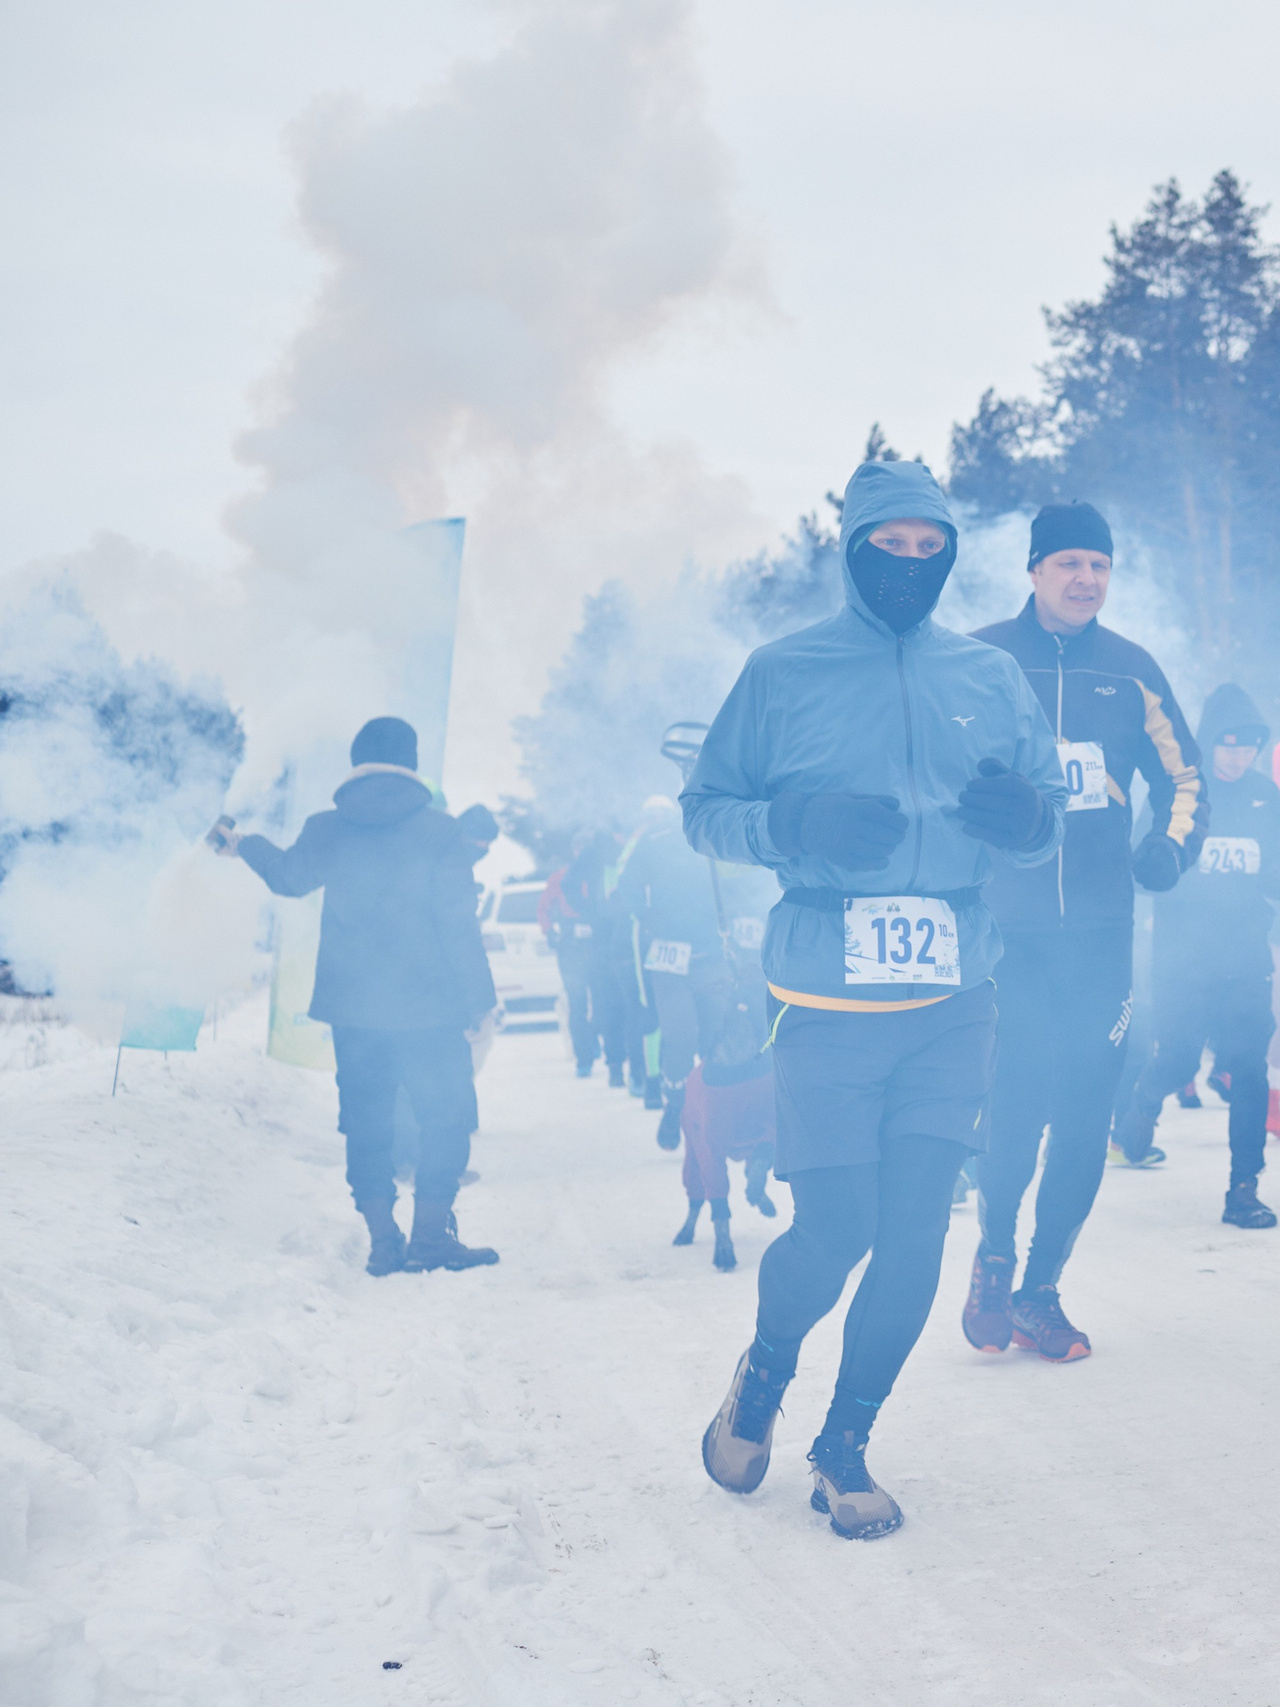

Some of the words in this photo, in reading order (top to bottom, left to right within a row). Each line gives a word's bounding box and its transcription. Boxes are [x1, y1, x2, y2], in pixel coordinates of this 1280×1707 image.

[1209, 848, 1246, 872] 243
[871, 917, 936, 965] 132
[938, 924, 947, 937] 10
